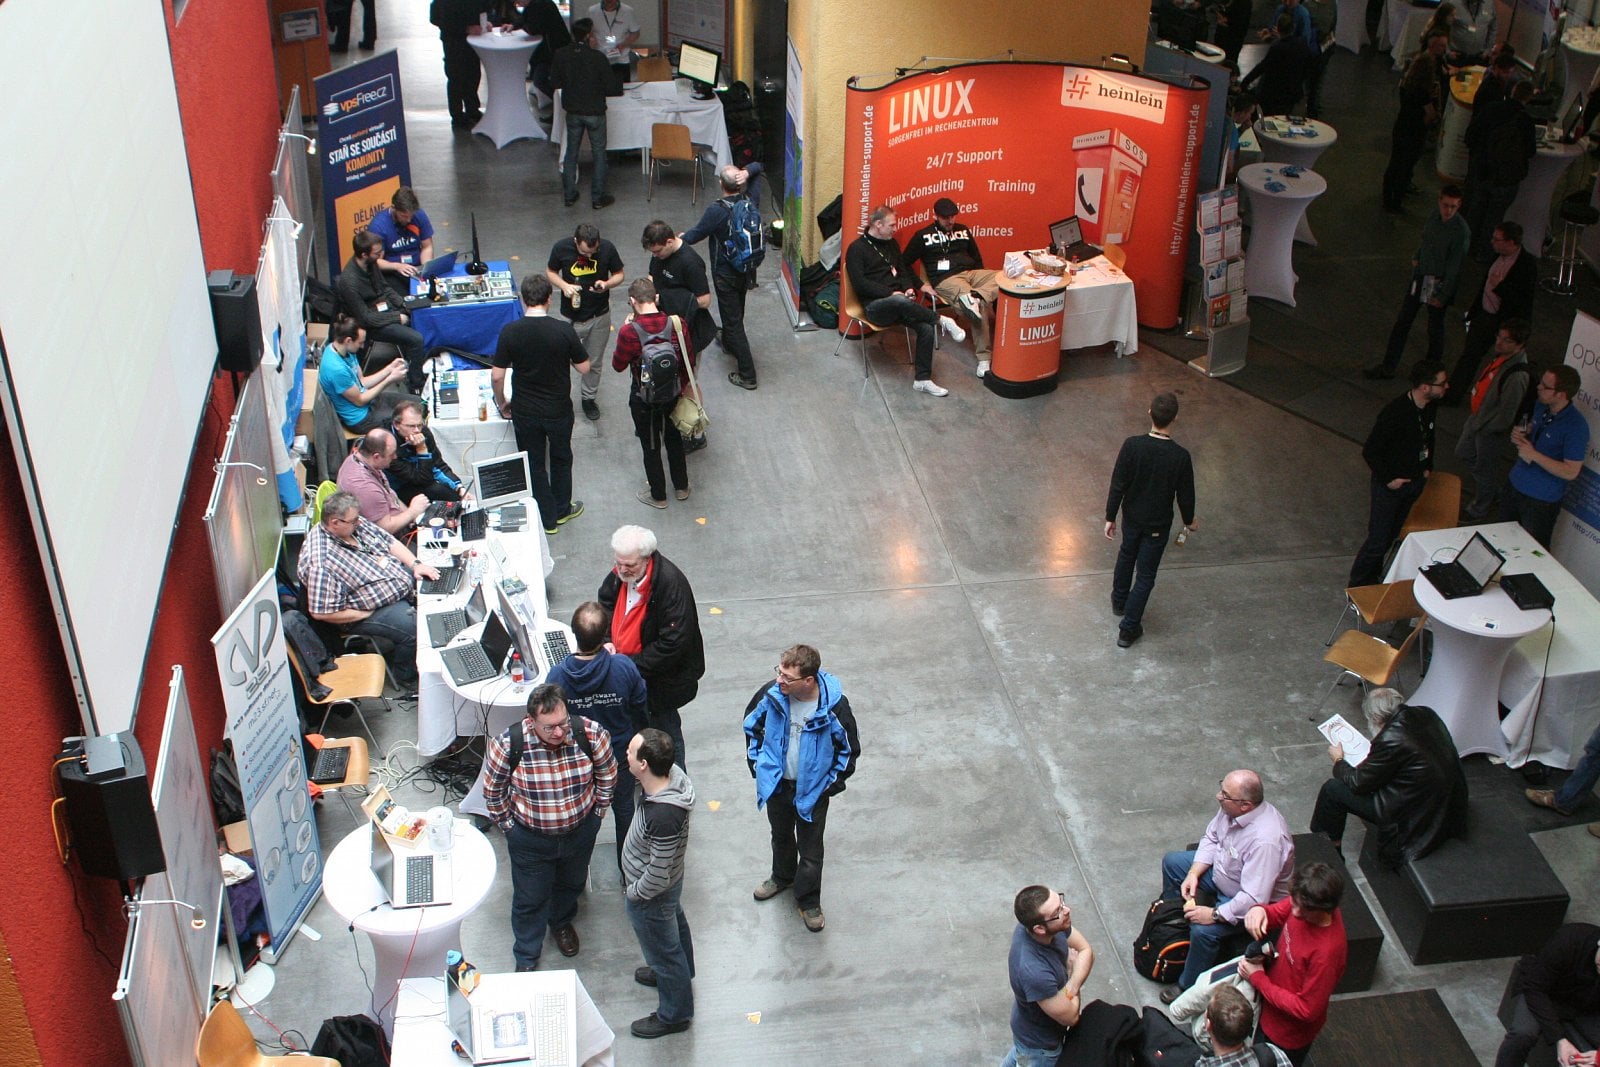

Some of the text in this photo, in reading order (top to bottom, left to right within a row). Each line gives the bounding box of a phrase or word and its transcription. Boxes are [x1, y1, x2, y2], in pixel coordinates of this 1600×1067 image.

[889, 79, 975, 134] LINUX
[1098, 83, 1163, 109] heinlein
[329, 125, 397, 165] STAŇ SE SOUČÁSTÍ
[888, 117, 999, 147] SORGENFREI IM RECHENZENTRUM
[345, 148, 385, 173] KOMUNITY
[926, 148, 1003, 169] 24/7 Support
[1125, 139, 1144, 160] SOS
[857, 104, 874, 236] //www.heinlein-support.de
[1170, 103, 1200, 255] http://www.heinlein-support.de
[885, 178, 1036, 208] Linux-Consulting Training
[897, 208, 930, 230] Hosted
[1020, 323, 1056, 341] LINUX
